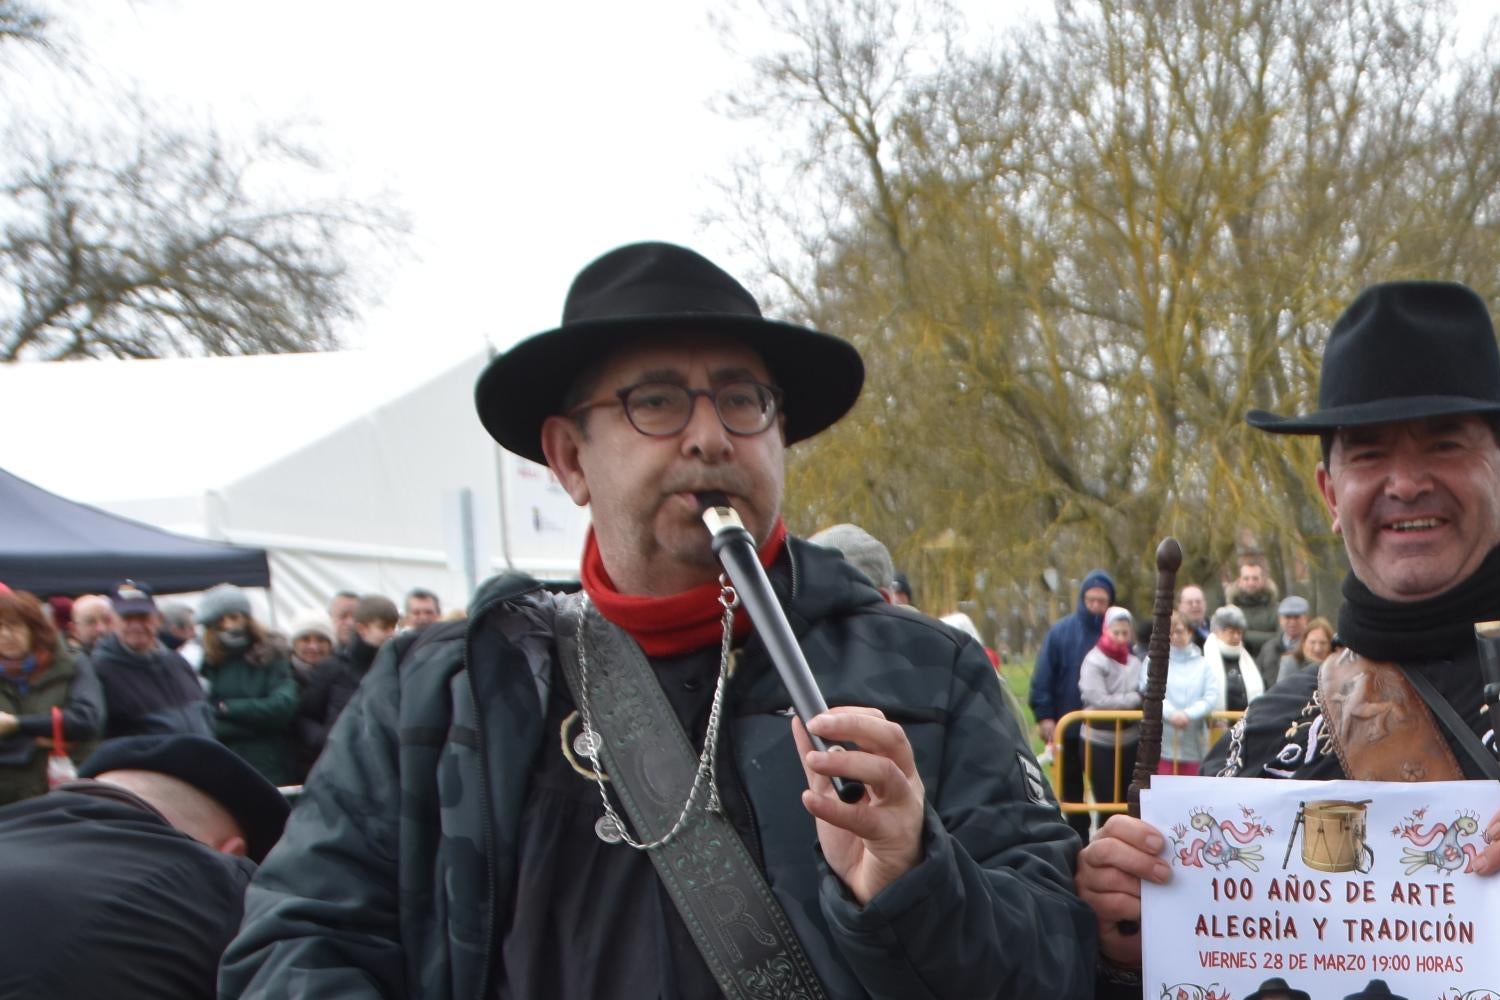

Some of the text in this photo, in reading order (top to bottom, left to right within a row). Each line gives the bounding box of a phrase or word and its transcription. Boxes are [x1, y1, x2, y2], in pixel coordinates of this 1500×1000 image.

[1211, 873, 1456, 906] 100 AÑOS DE ARTE
[1194, 909, 1475, 944] ALEGRÍA Y TRADICIÓN
[1199, 950, 1464, 973] VIERNES 28 DE MARZO 19:00 HORAS
